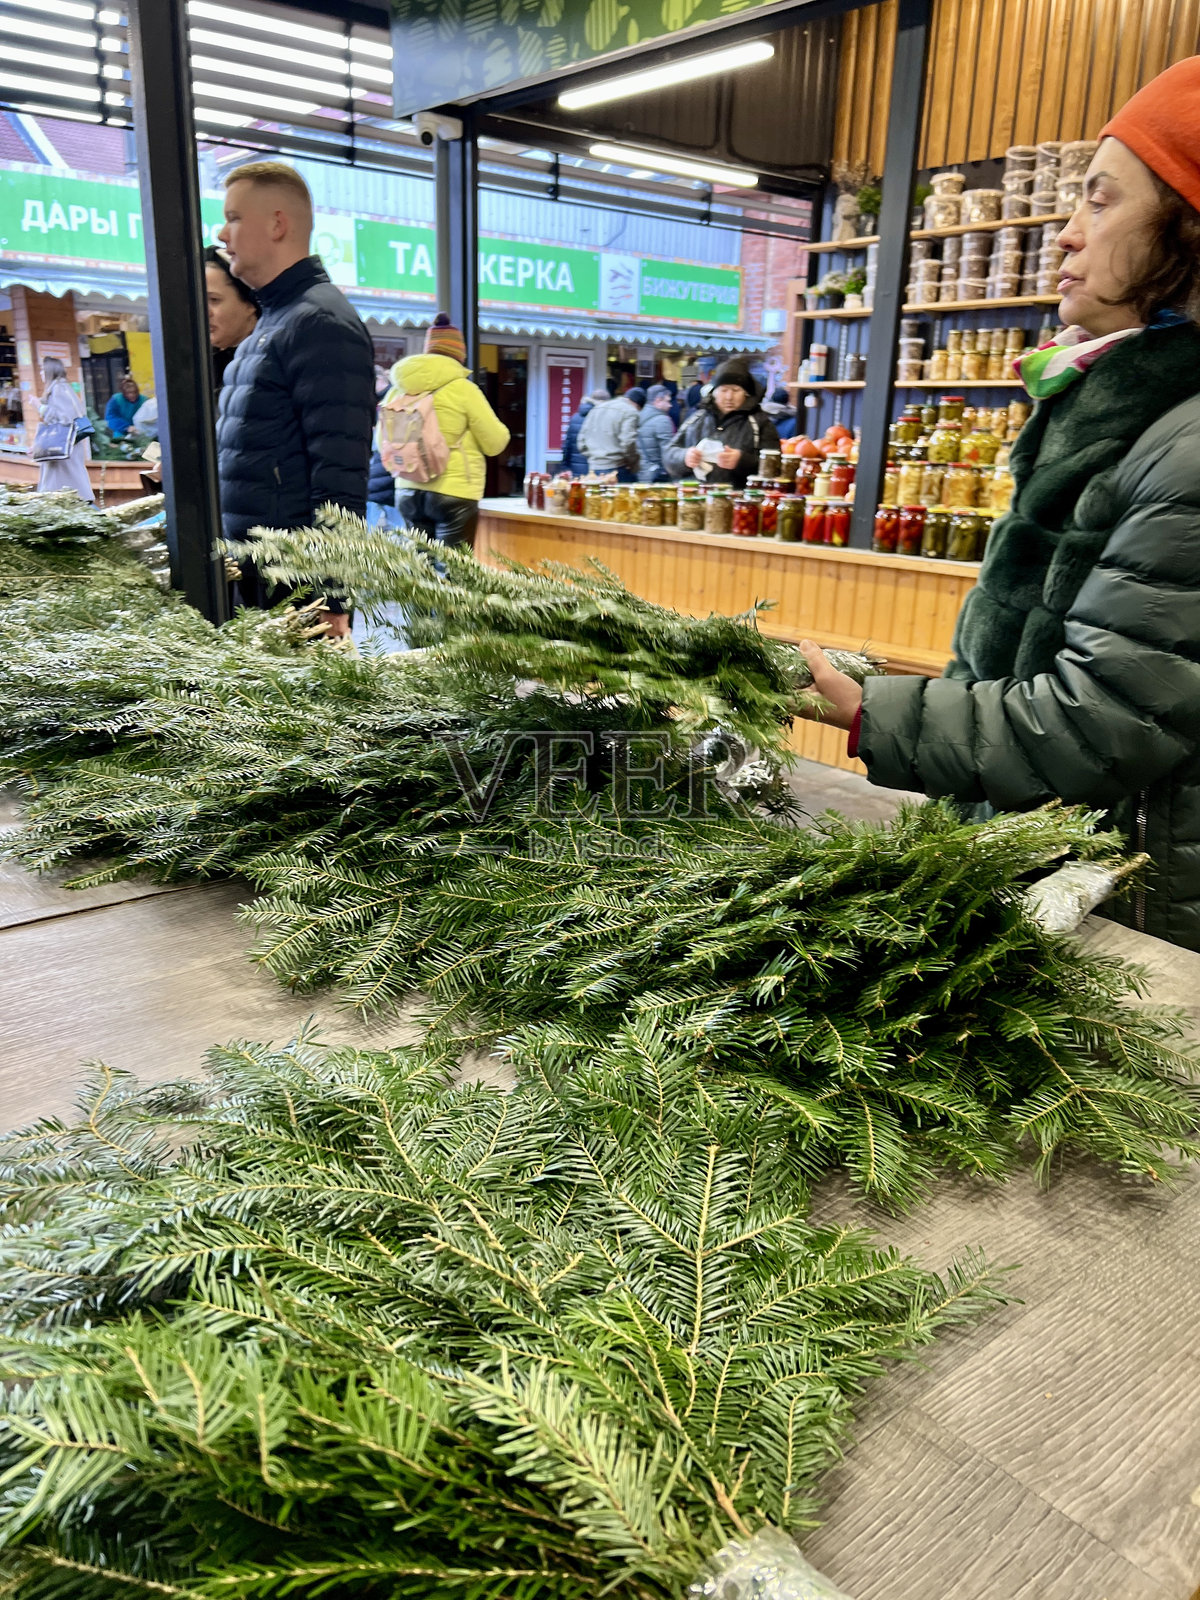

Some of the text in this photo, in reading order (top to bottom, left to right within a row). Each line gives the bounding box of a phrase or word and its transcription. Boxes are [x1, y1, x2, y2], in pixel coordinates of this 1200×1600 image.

[21, 199, 118, 236] ДАРЫ
[389, 240, 575, 292] ТАКЕРКА
[643, 277, 739, 305] БИЖУТЕРИЯ
